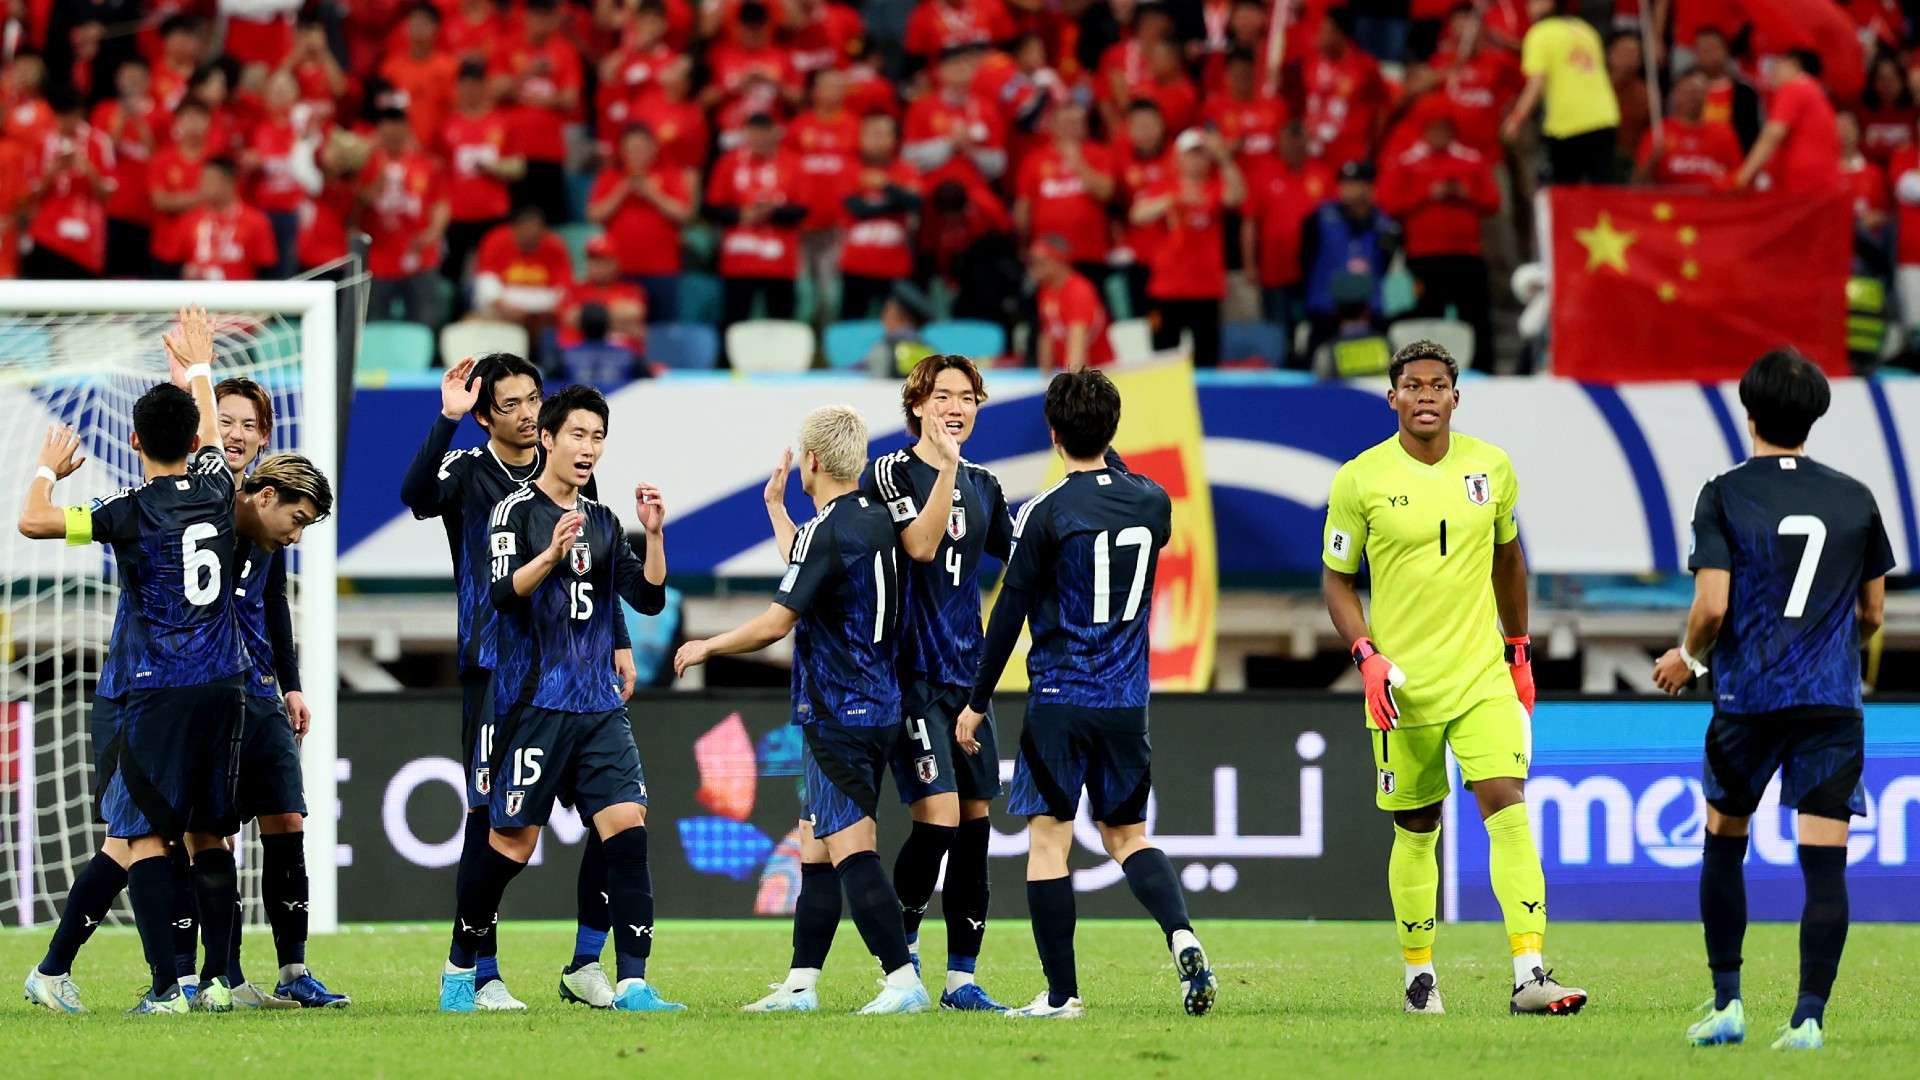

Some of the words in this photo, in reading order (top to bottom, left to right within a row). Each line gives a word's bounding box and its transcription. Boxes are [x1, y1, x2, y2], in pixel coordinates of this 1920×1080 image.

[1388, 495, 1410, 507] Y-3
[1439, 519, 1447, 556] 1
[182, 522, 222, 606] 6
[945, 546, 962, 586] 4
[1093, 526, 1153, 624] 17
[1777, 514, 1827, 618] 7
[569, 581, 594, 620] 15
[873, 546, 898, 643] 1
[906, 717, 932, 751] 4
[513, 747, 544, 786] 15
[172, 918, 192, 929] -3
[966, 917, 985, 930] Y-
[1401, 917, 1435, 933] Y-3
